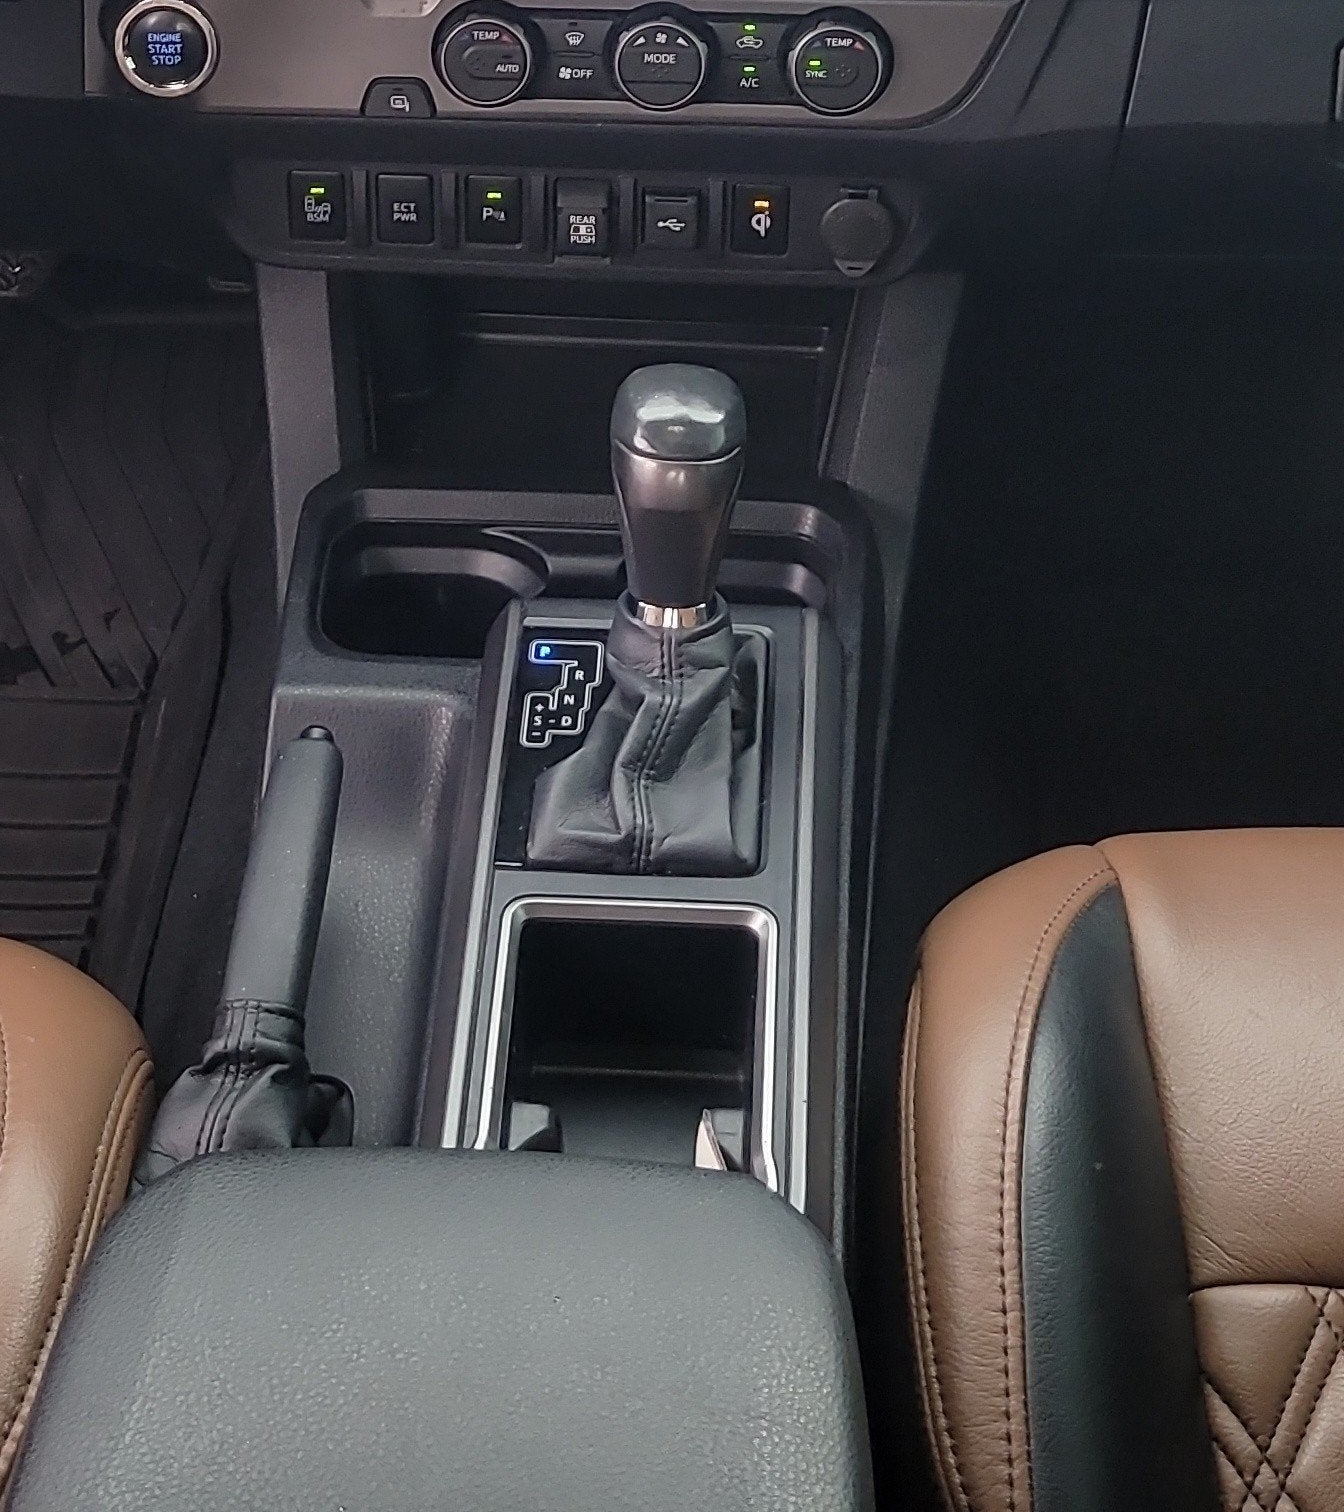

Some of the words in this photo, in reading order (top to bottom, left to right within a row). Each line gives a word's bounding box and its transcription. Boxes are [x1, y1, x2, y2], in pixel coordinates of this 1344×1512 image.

[147, 32, 183, 43] ENGINE
[471, 30, 500, 41] TEMP
[148, 43, 183, 54] START
[825, 37, 854, 48] TEMP
[151, 54, 182, 66] STOP
[643, 52, 677, 65] MODE
[494, 63, 520, 74] AUTO
[571, 68, 594, 80] OFF
[805, 69, 828, 79] SYNC
[739, 77, 760, 89] A/C
[392, 201, 417, 213] ECT
[305, 212, 330, 224] BSM
[392, 212, 418, 223] PWR
[568, 214, 597, 226] REAR
[569, 234, 597, 245] PUSH
[539, 645, 551, 658] P
[574, 669, 585, 682] R
[562, 693, 575, 706] N
[532, 714, 543, 727] S
[560, 714, 573, 727] D
